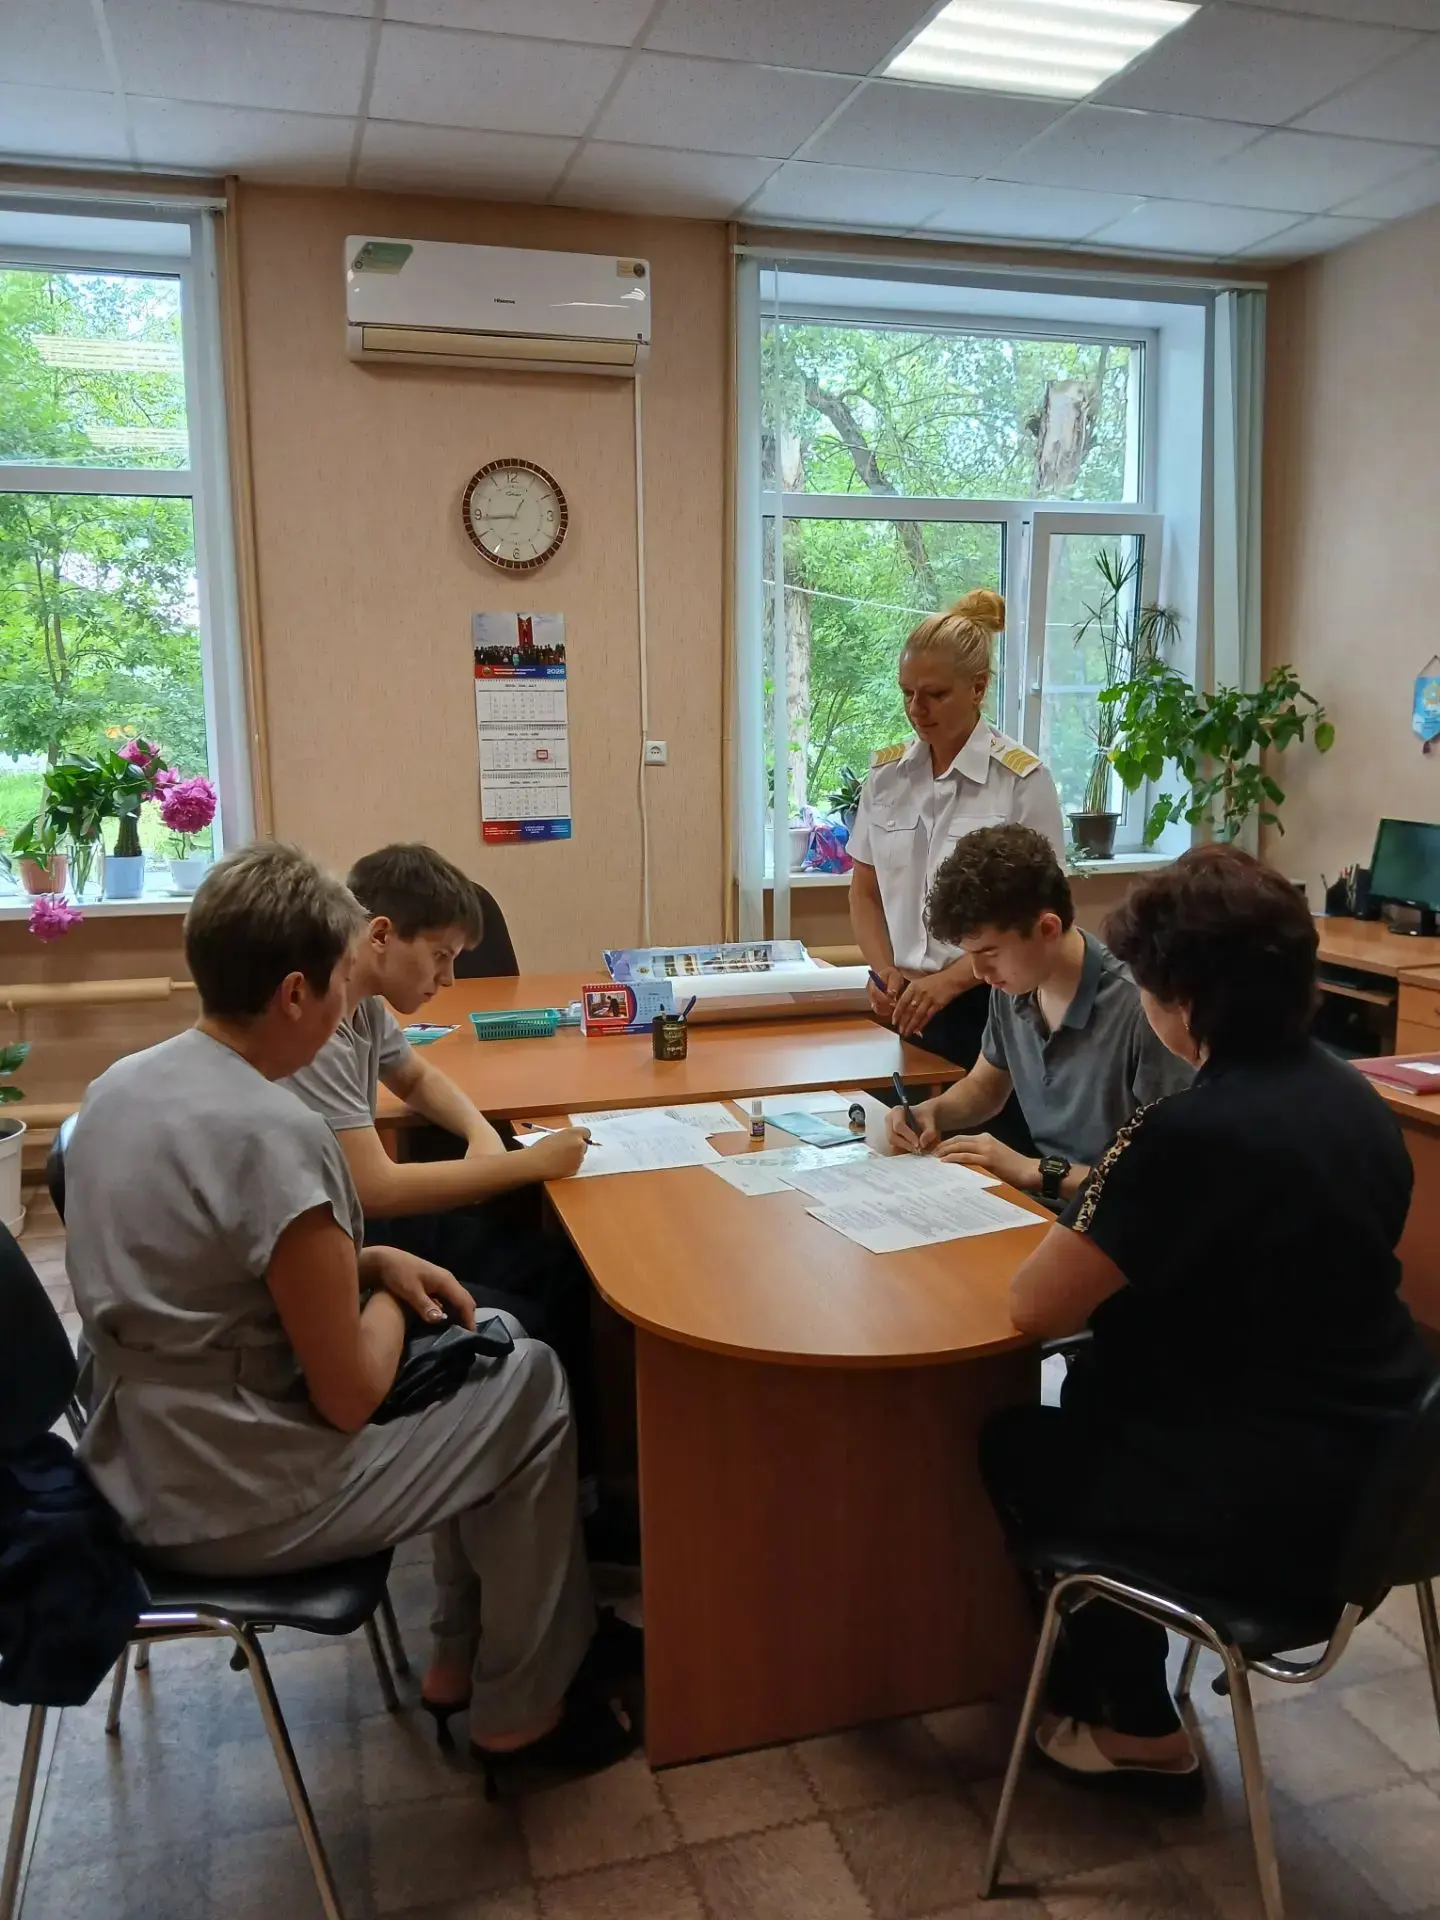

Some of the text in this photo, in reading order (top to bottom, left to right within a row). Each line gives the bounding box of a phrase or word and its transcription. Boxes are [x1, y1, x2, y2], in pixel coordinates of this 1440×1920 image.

[506, 472, 519, 483] 12
[475, 509, 482, 520] 9
[547, 510, 554, 521] 3
[513, 548, 520, 559] 6
